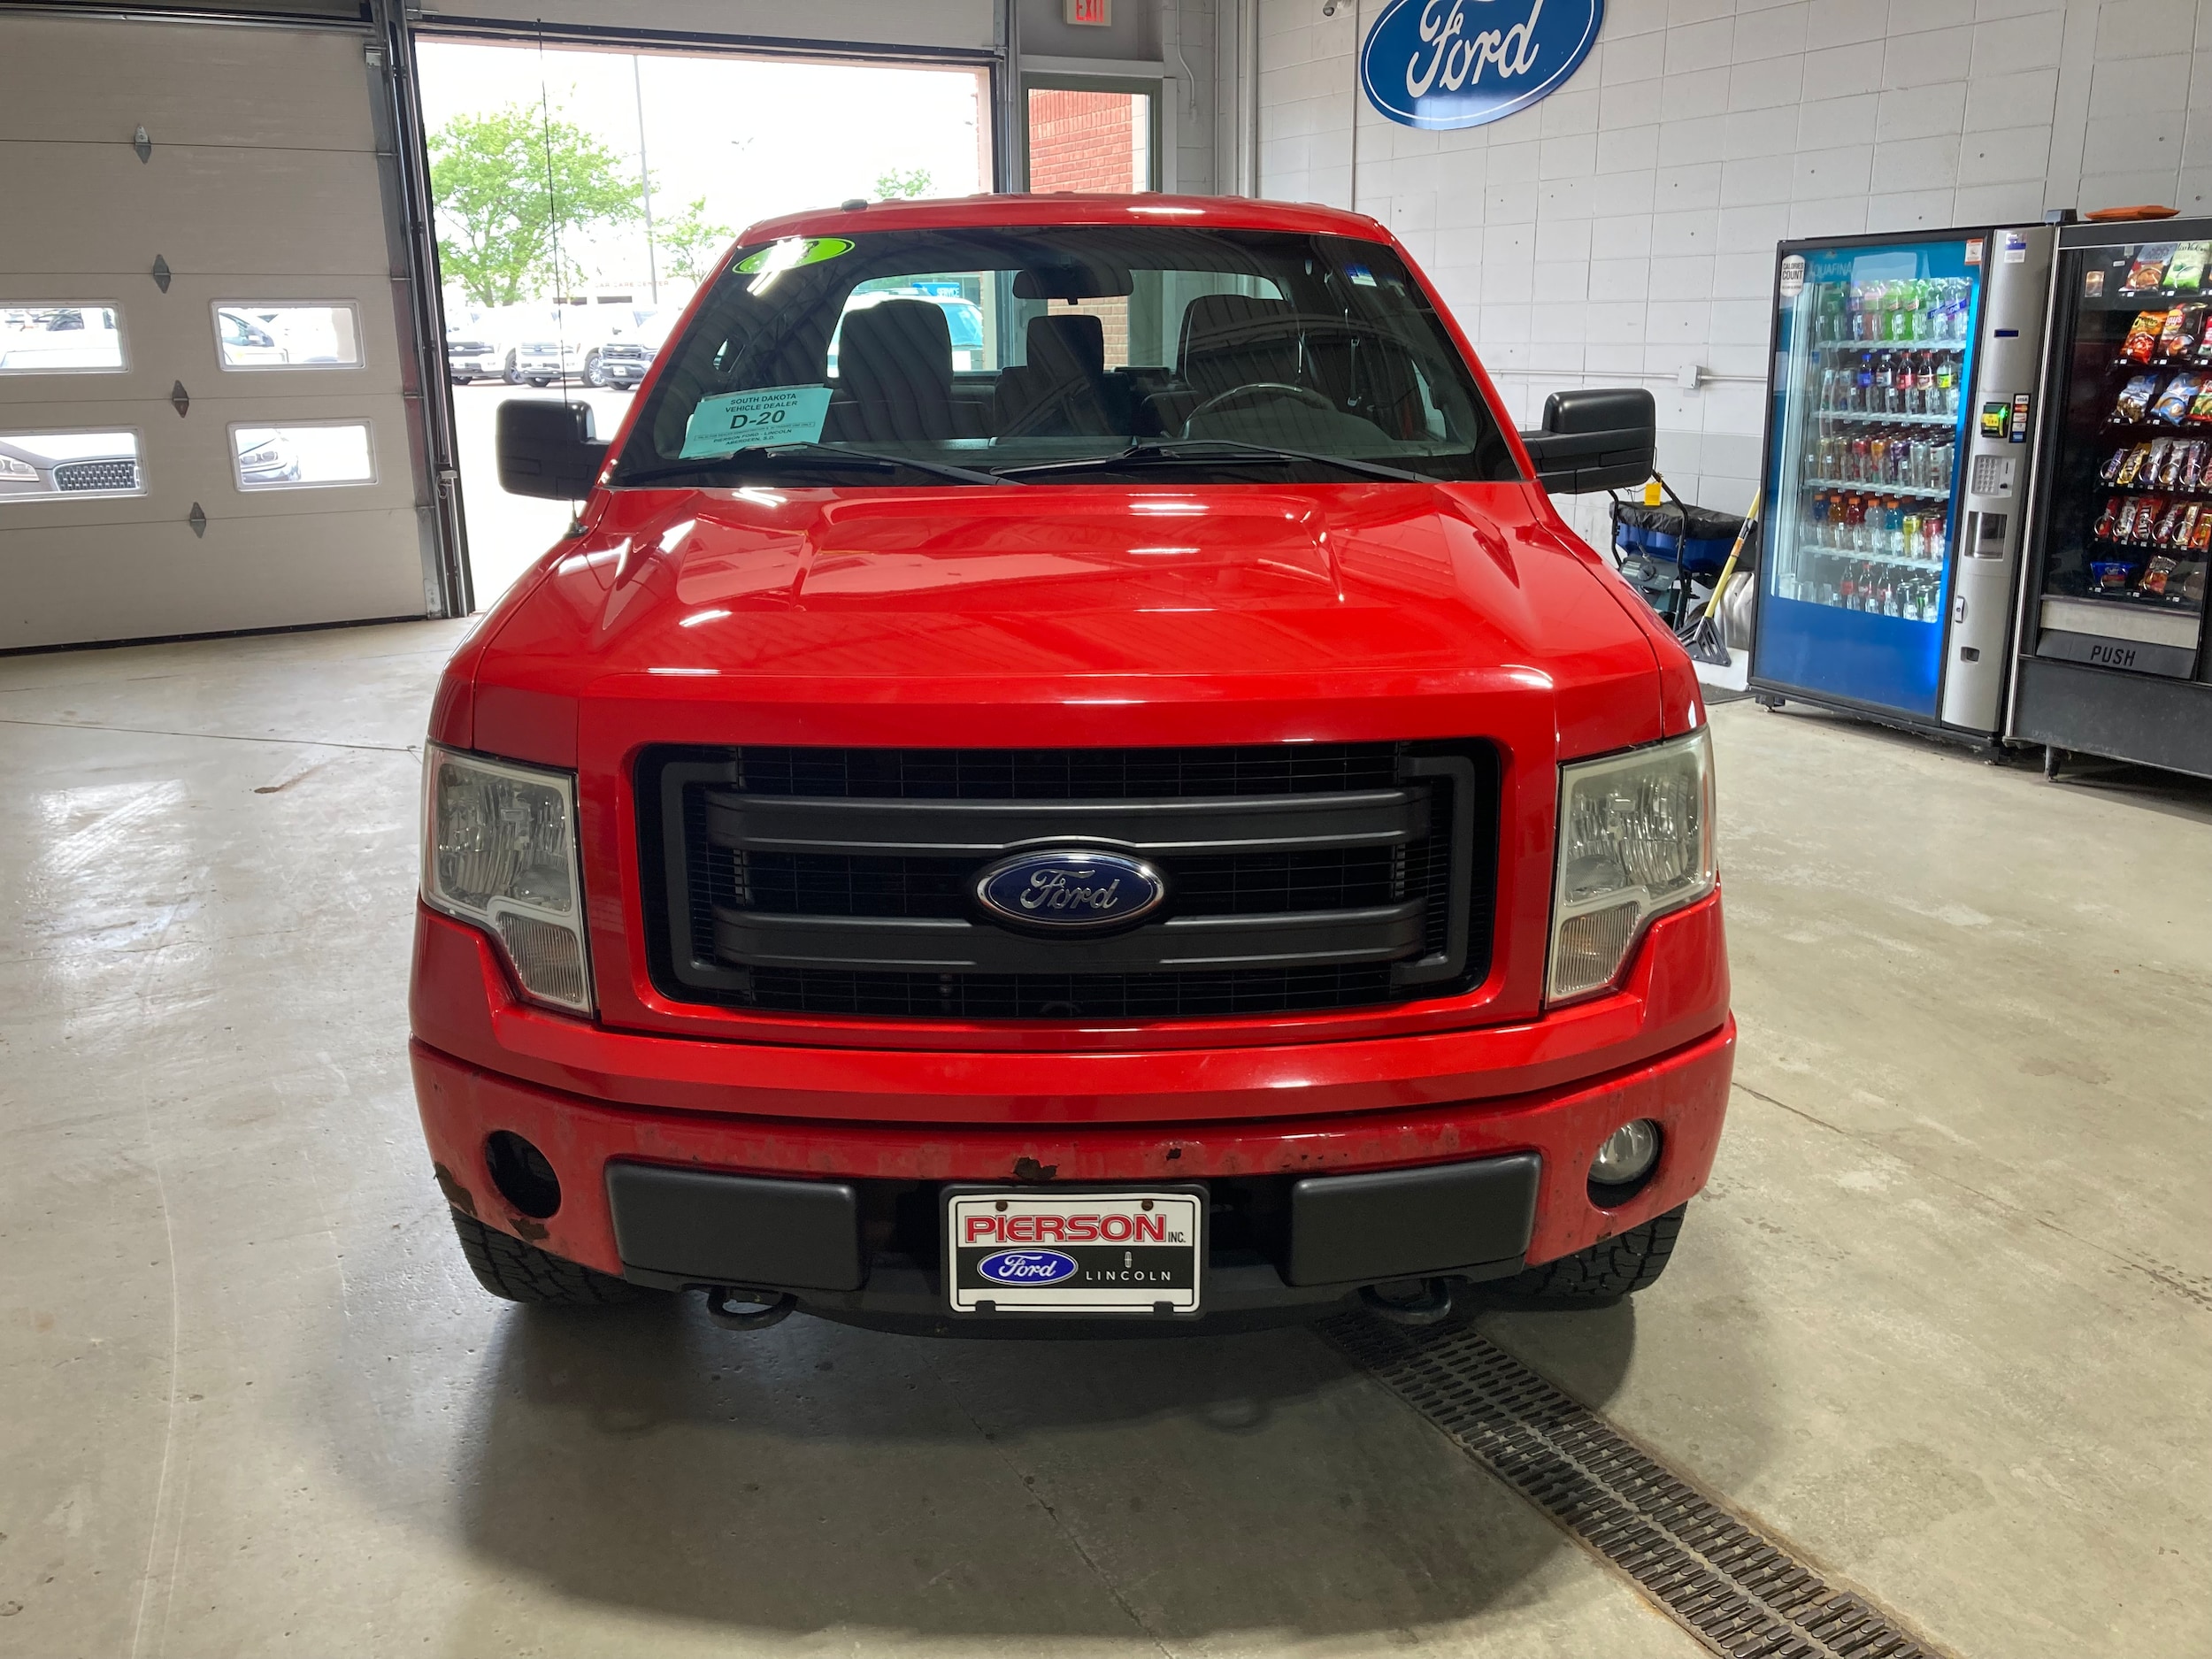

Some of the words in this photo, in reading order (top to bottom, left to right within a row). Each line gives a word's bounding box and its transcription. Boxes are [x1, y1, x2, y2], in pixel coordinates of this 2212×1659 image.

[1406, 0, 1540, 98] Ford
[1782, 270, 1803, 280] COUNT
[761, 393, 796, 402] DAKOTA
[730, 410, 786, 429] D-20
[2090, 644, 2137, 667] PUSH
[1019, 868, 1121, 910] Ford
[964, 1214, 1167, 1243] PIERSON
[1167, 1231, 1187, 1243] INC.
[998, 1254, 1058, 1278] Ford
[1086, 1271, 1171, 1281] LINCOLN
